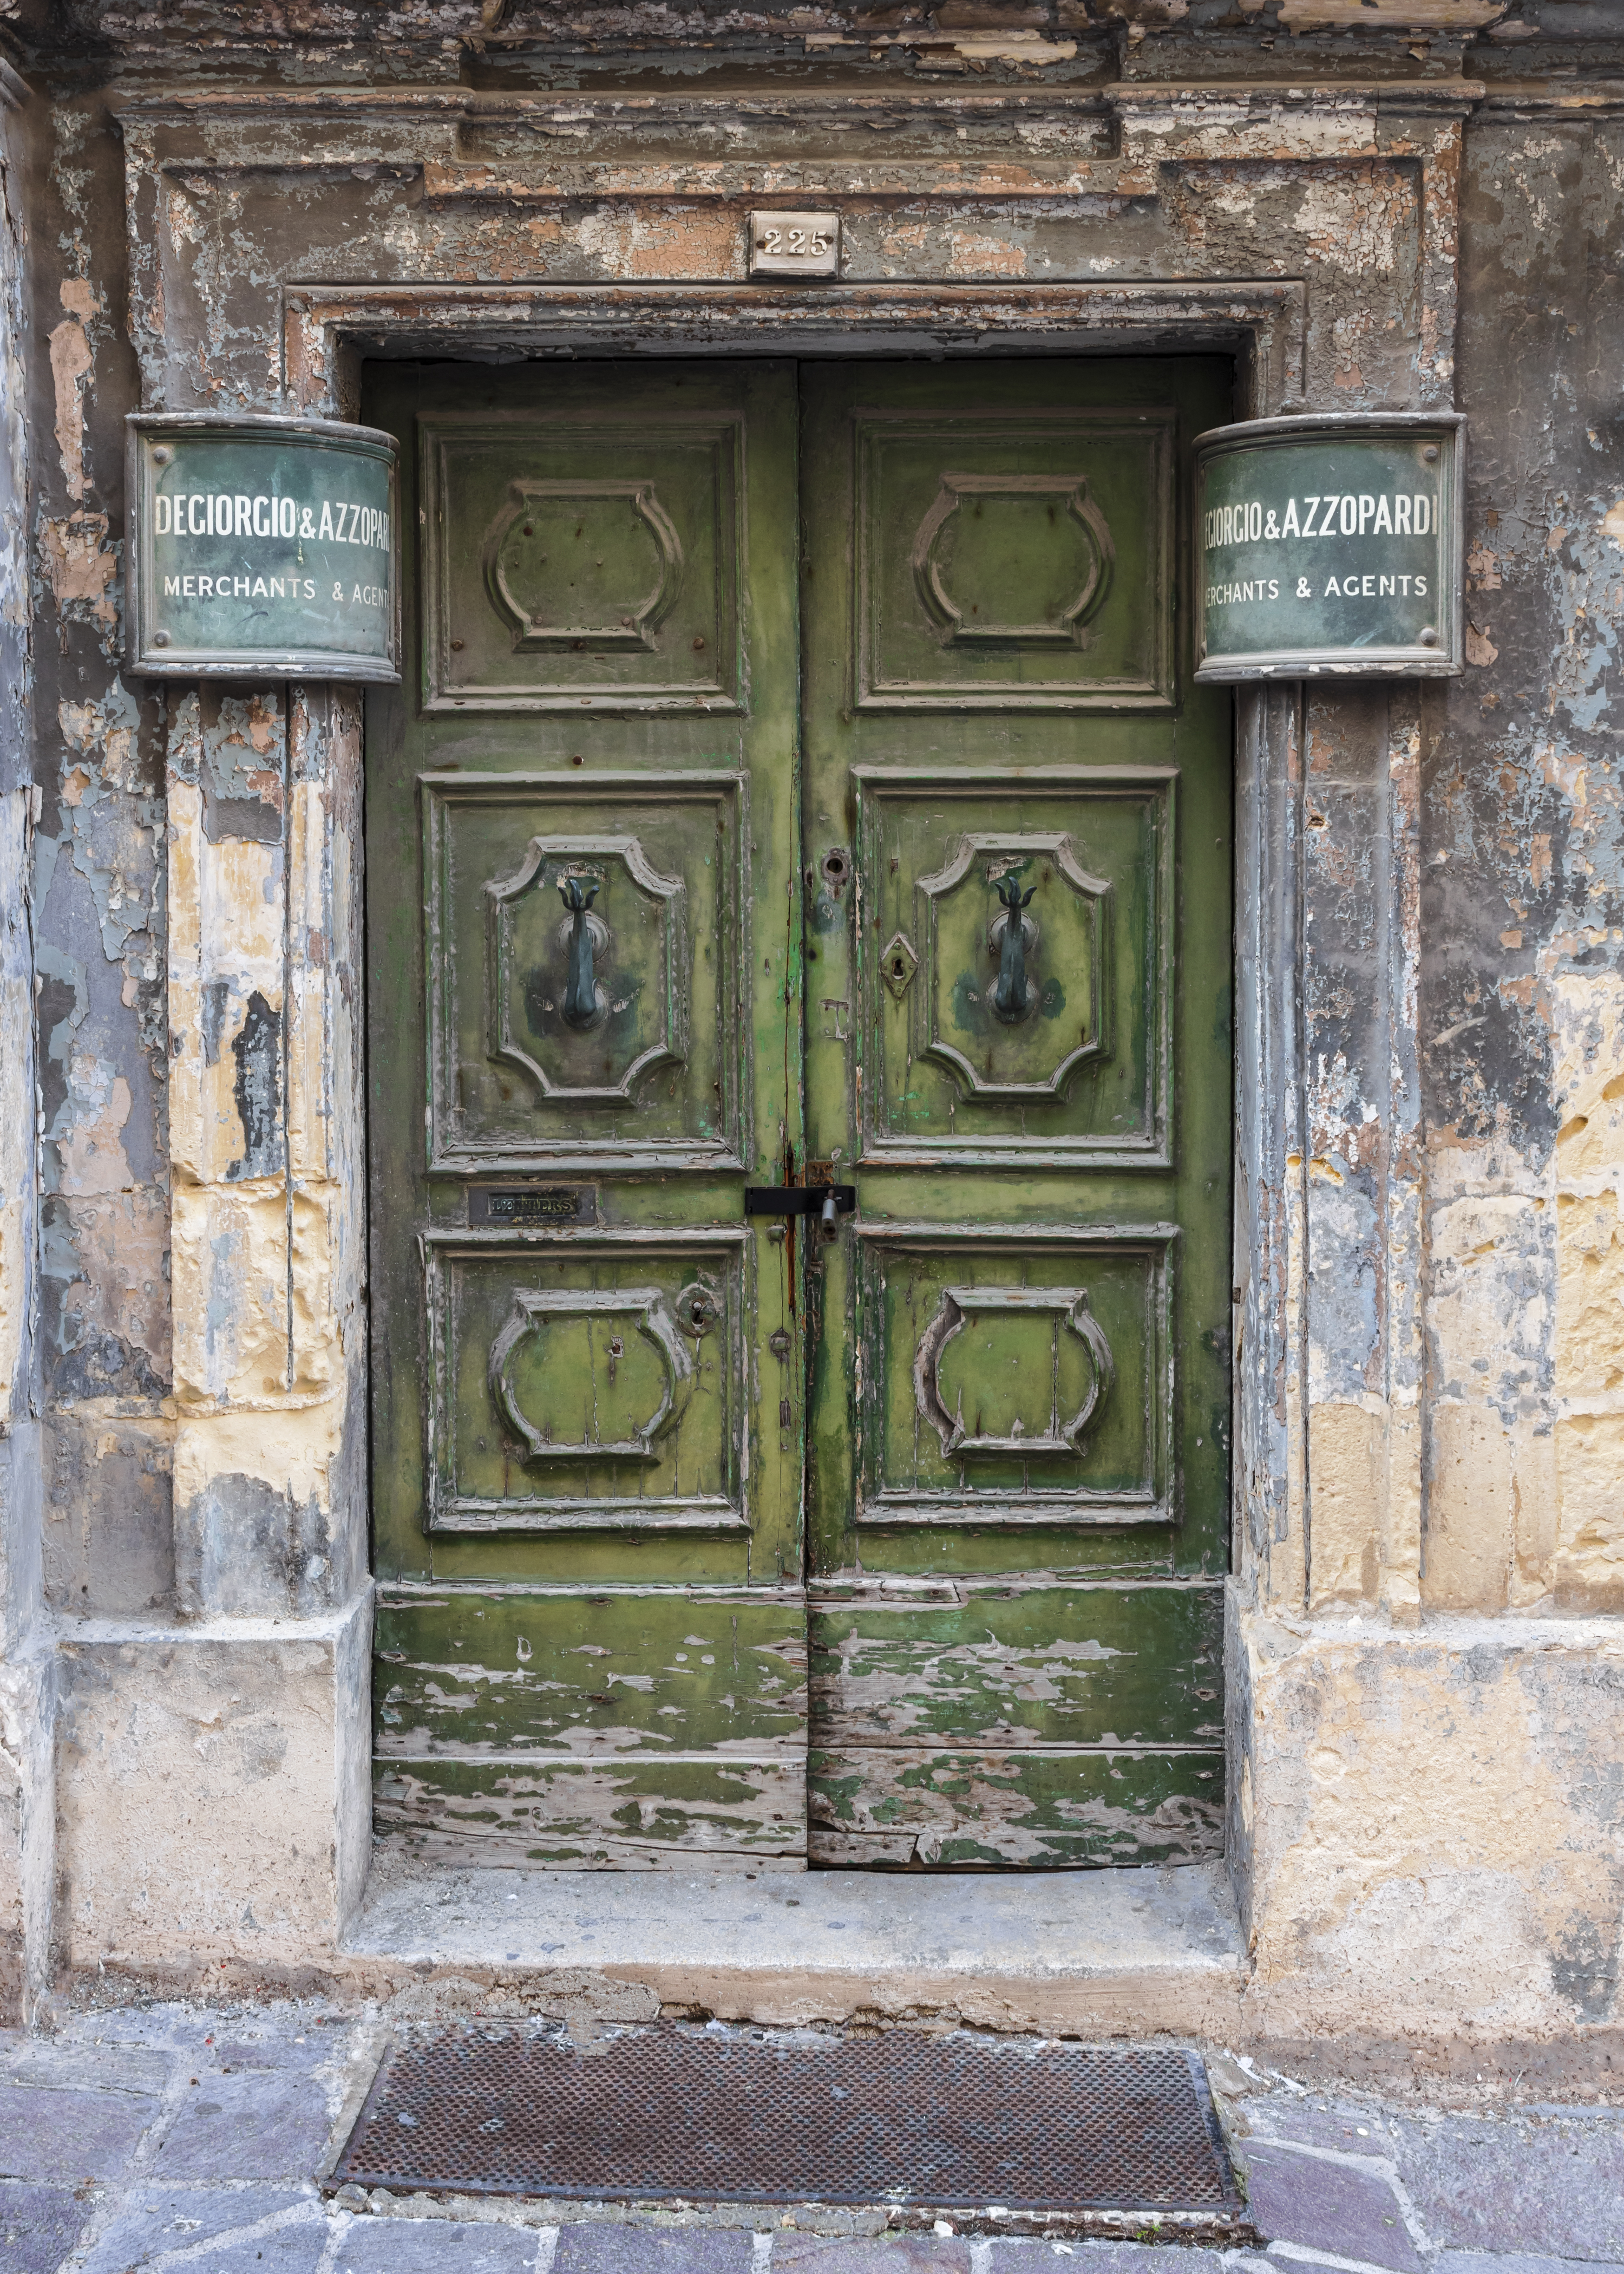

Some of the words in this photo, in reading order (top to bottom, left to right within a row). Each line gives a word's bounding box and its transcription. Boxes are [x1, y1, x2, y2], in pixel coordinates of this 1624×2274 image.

[764, 229, 827, 256] 225
[155, 495, 296, 538] DEGIORGIO
[1205, 502, 1262, 551] EGIORGIO
[1281, 494, 1437, 538] AZZOPARDI
[164, 576, 315, 600] MERCHANTS
[332, 581, 344, 602] &
[1206, 579, 1279, 607] ERCHANTS
[1296, 577, 1311, 598] &
[1324, 576, 1427, 597] AGENTS
[492, 1198, 571, 1212] LETTERS
